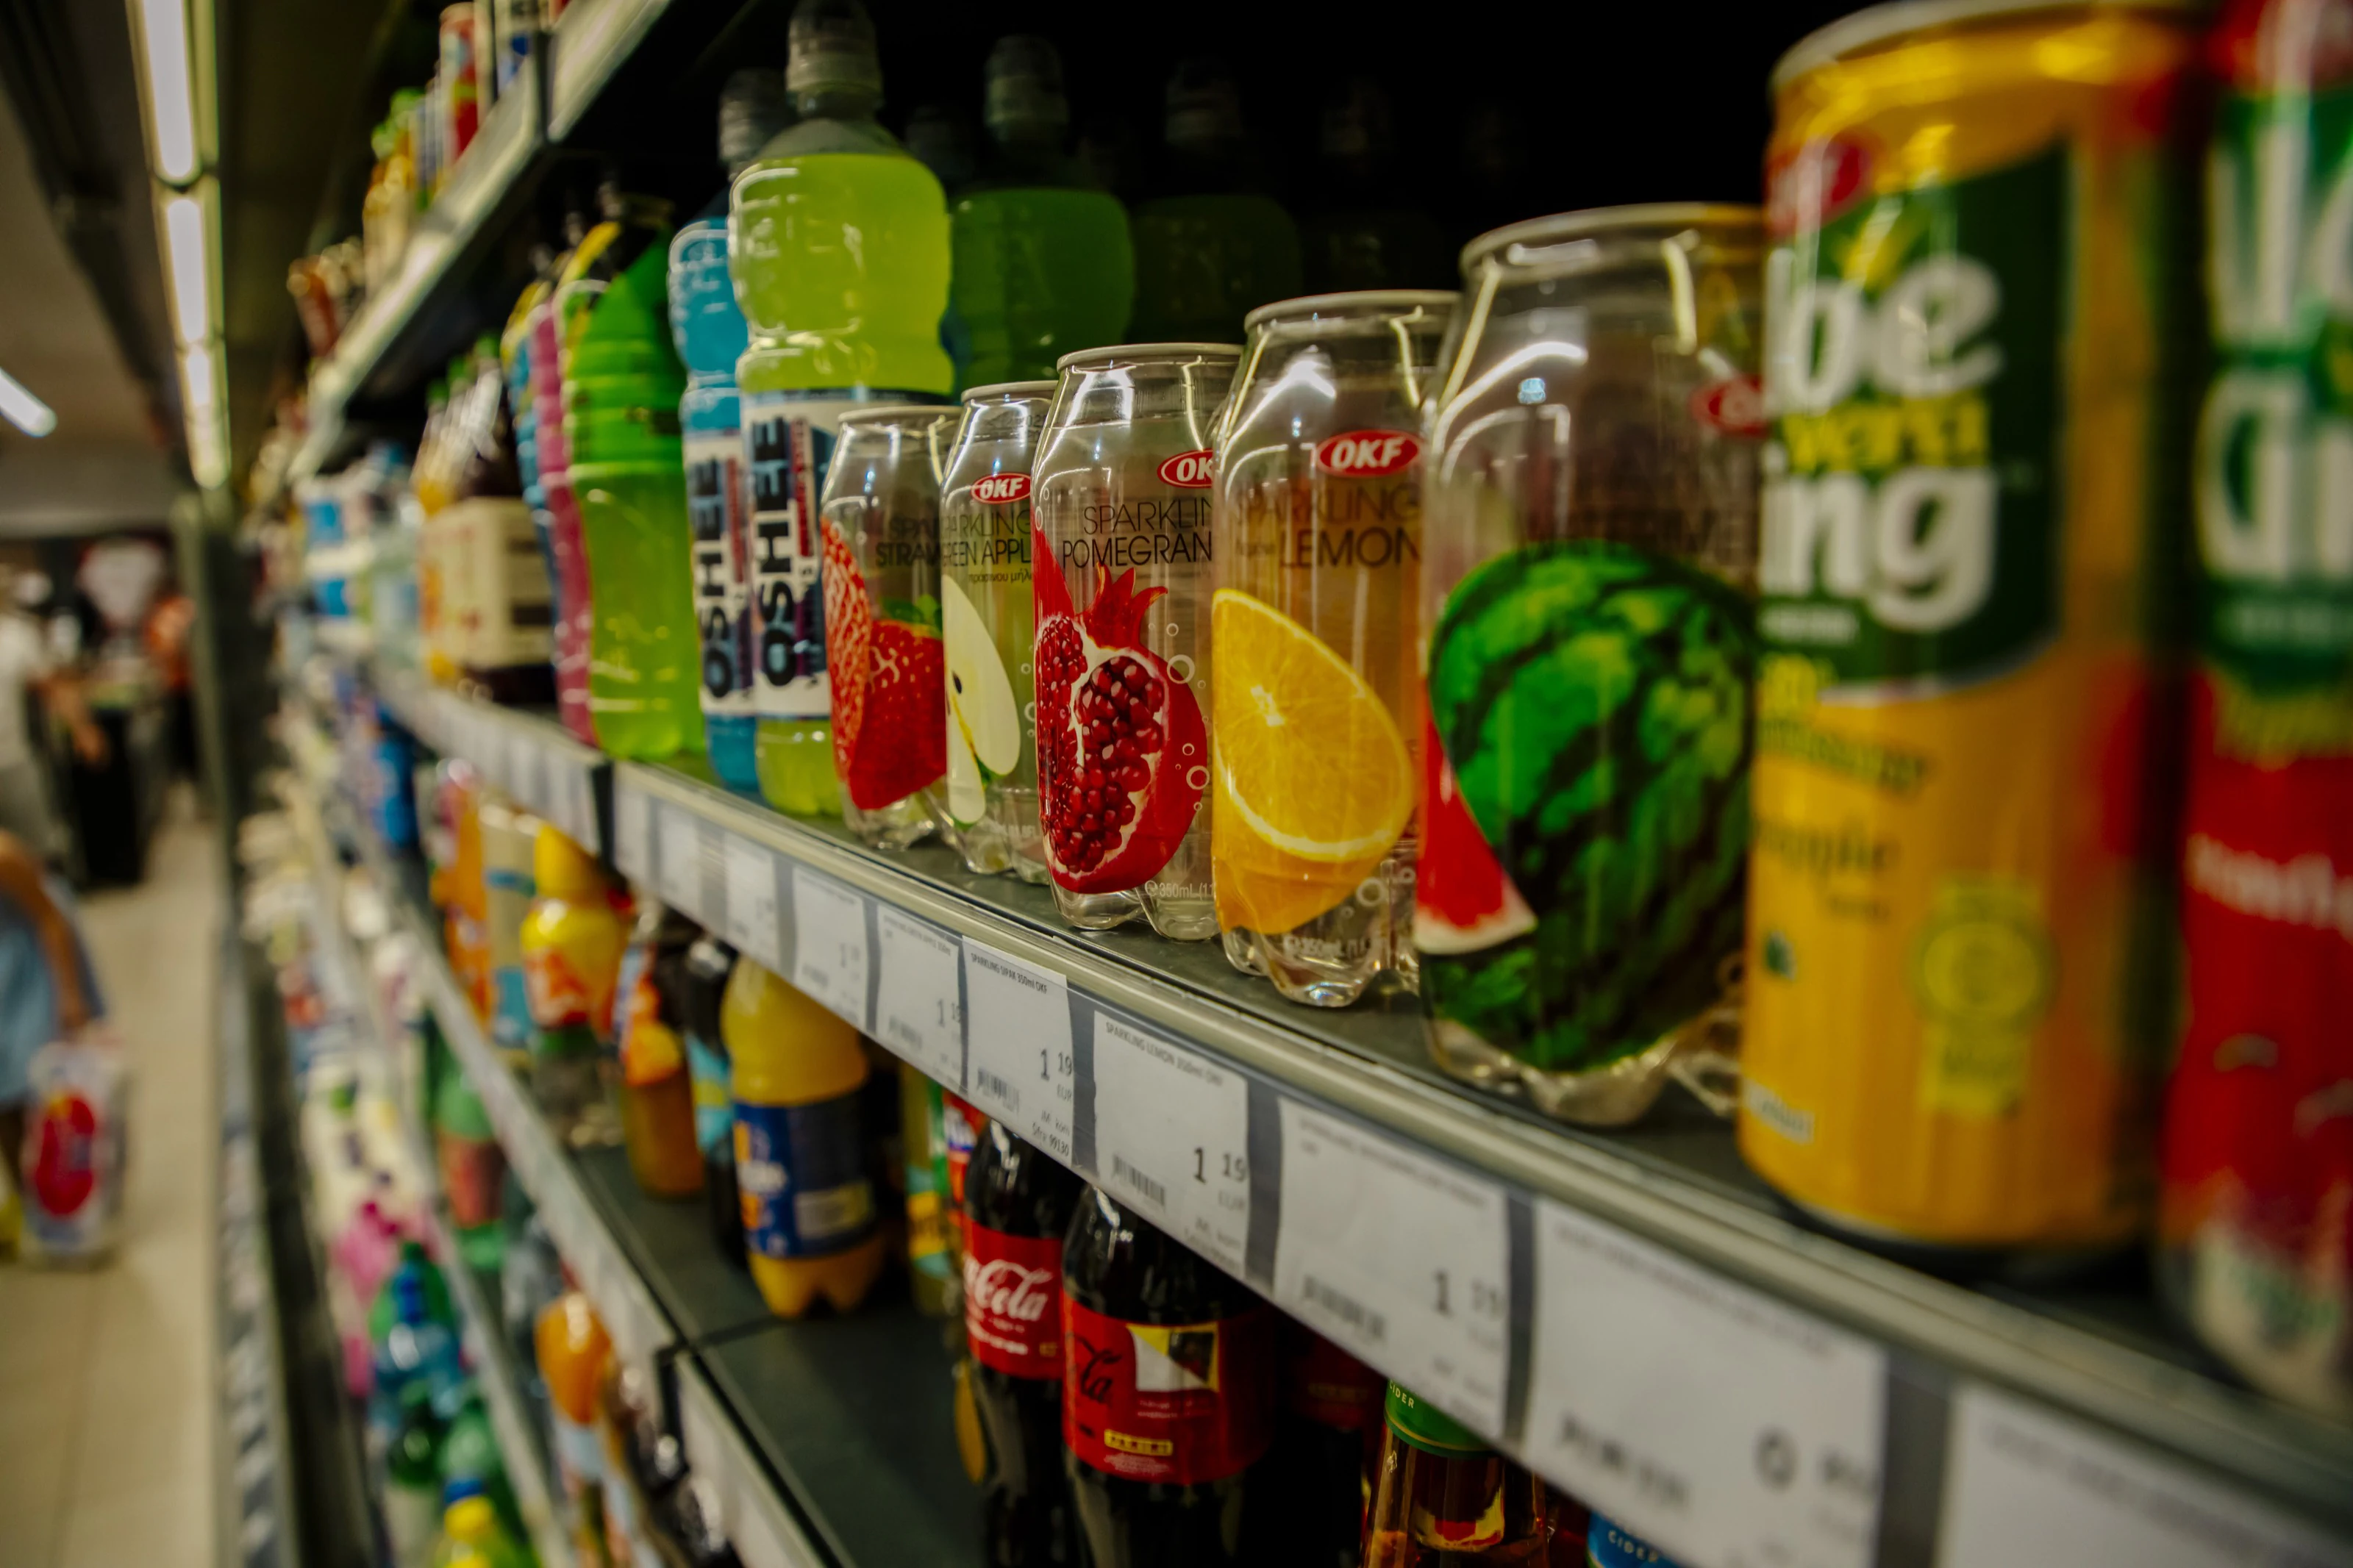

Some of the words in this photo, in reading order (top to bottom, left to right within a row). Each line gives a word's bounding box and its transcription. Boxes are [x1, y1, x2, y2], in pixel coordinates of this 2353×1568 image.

[1176, 457, 1213, 482] OK
[1332, 437, 1405, 470] OKF
[979, 477, 1024, 499] OKF
[1084, 497, 1212, 535] SPARKLIN
[752, 417, 797, 687] OSHEE
[982, 538, 1031, 565] APPL
[1063, 531, 1212, 570] POMEGRAN
[1280, 526, 1421, 570] LEMON
[1040, 1048, 1050, 1082] 1
[1057, 1051, 1073, 1077] 19
[1193, 1147, 1206, 1184] 1
[1390, 1379, 1415, 1409] CIDER
